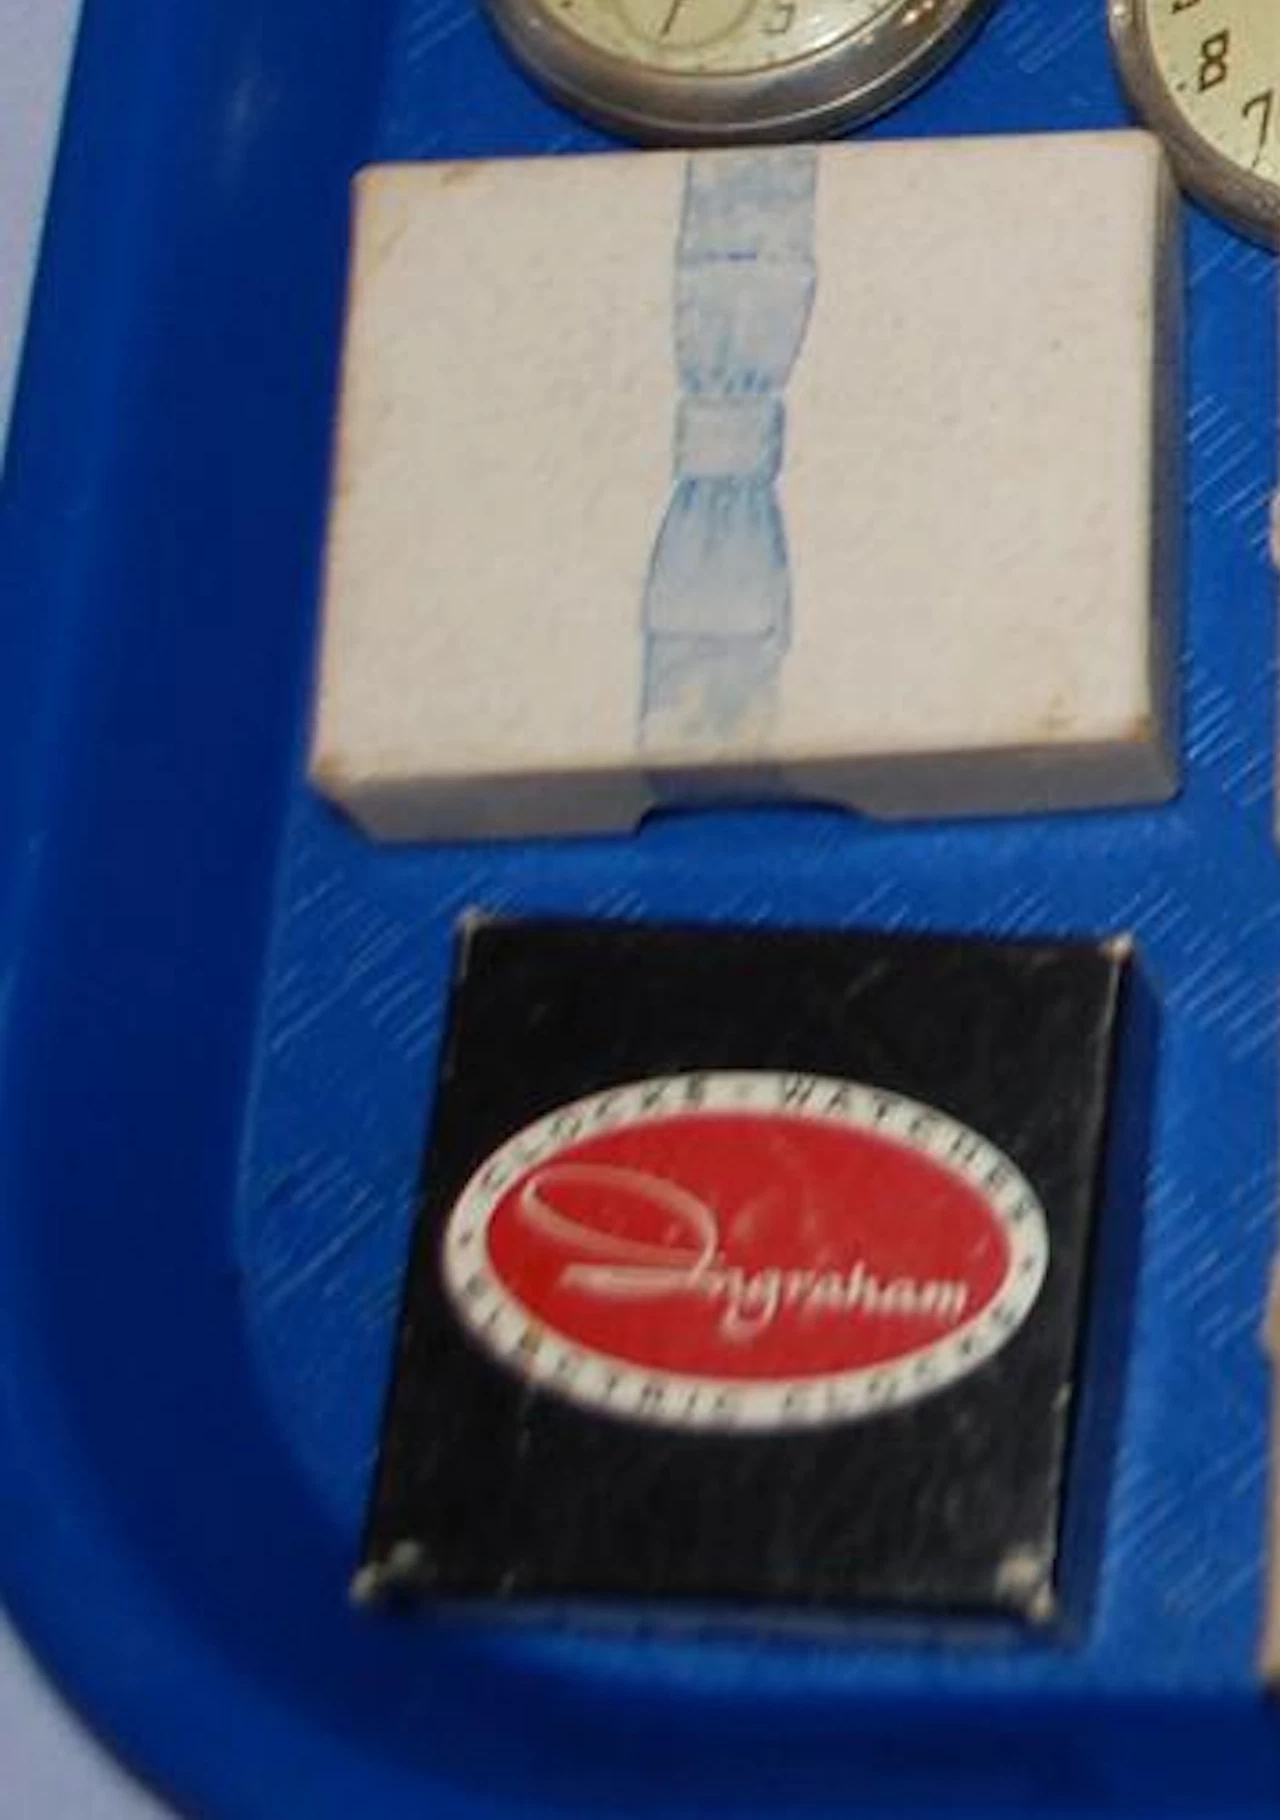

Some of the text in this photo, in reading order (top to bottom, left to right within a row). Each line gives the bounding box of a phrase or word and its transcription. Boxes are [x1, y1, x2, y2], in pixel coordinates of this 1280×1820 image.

[1198, 31, 1231, 91] 8
[1240, 90, 1274, 168] 7
[518, 1162, 968, 1344] Ingraham
